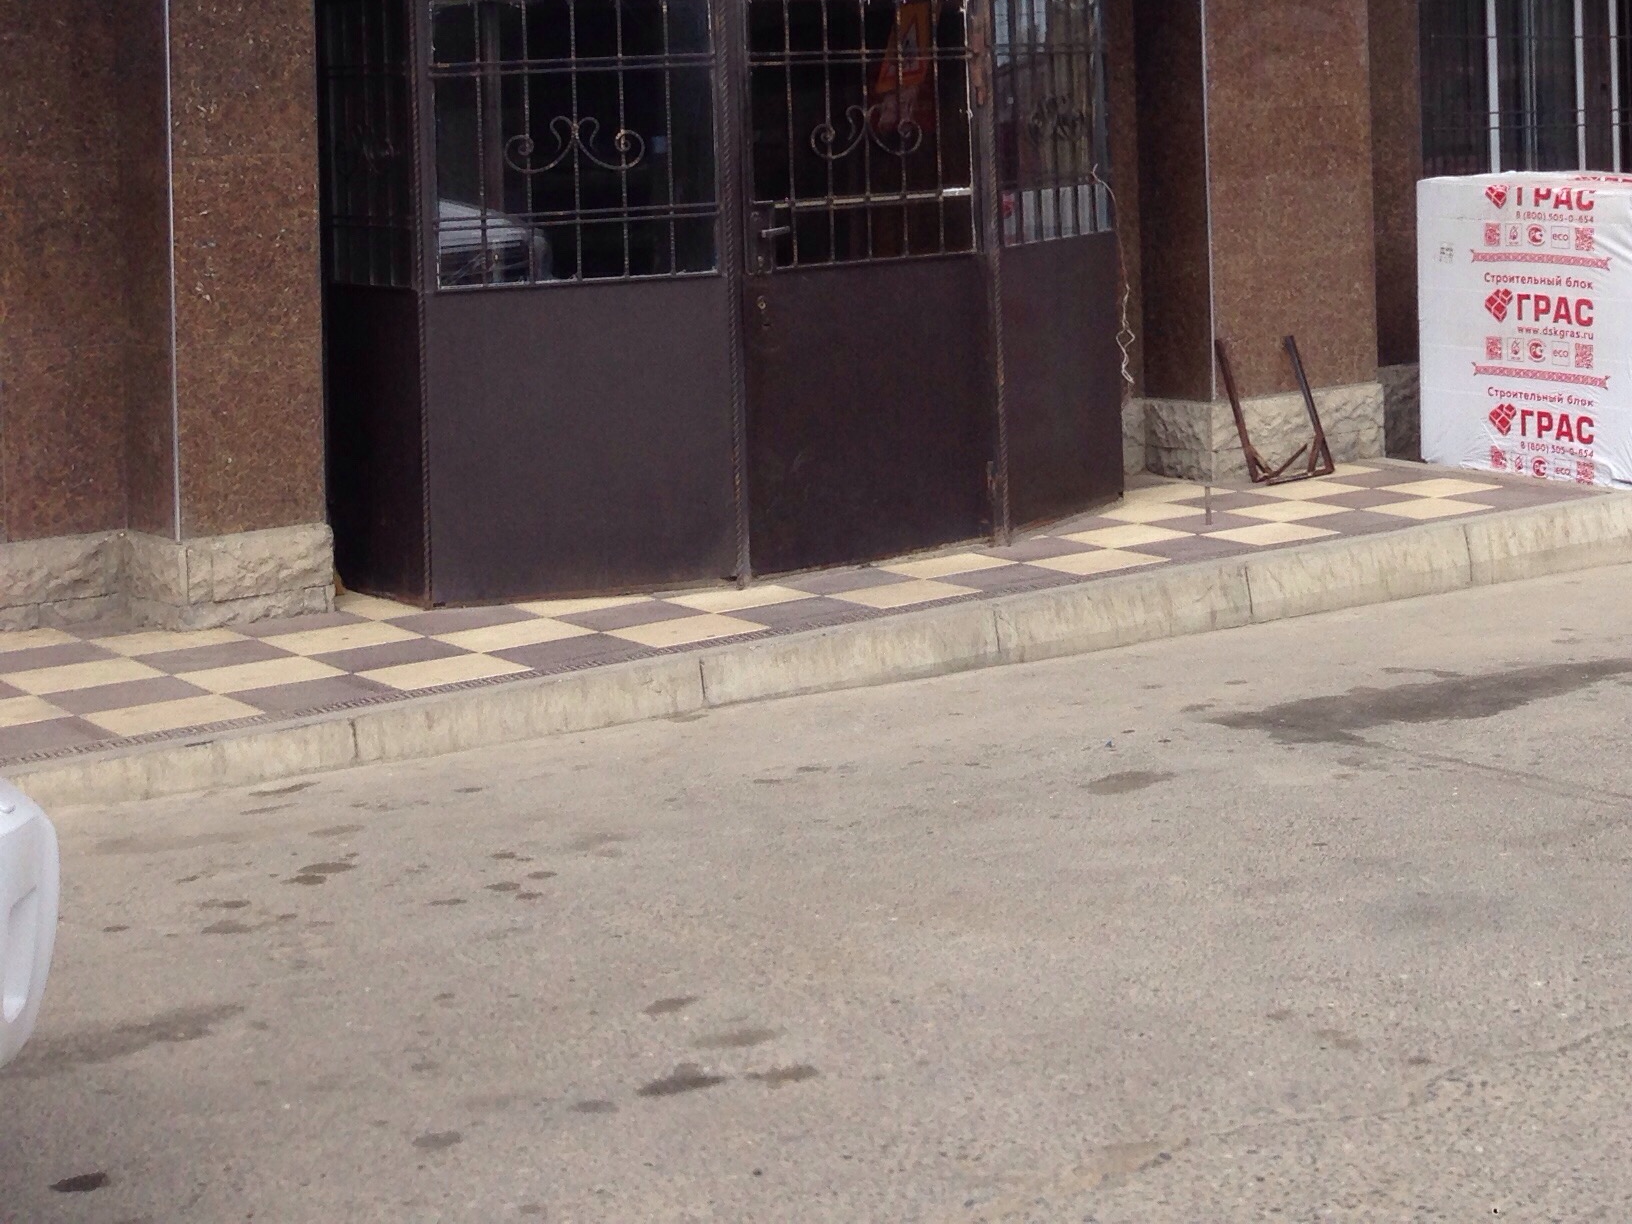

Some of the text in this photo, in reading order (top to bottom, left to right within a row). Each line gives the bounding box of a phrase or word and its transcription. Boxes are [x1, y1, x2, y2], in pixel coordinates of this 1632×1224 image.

[1552, 232, 1568, 242] eco
[1484, 272, 1594, 290] Строительный блок
[1516, 293, 1594, 327] ГРАС
[1517, 325, 1594, 341] www.dskgras.ru
[1552, 348, 1569, 358] eco
[1487, 386, 1595, 408] Строительный блок
[1520, 409, 1595, 445] ГРАС
